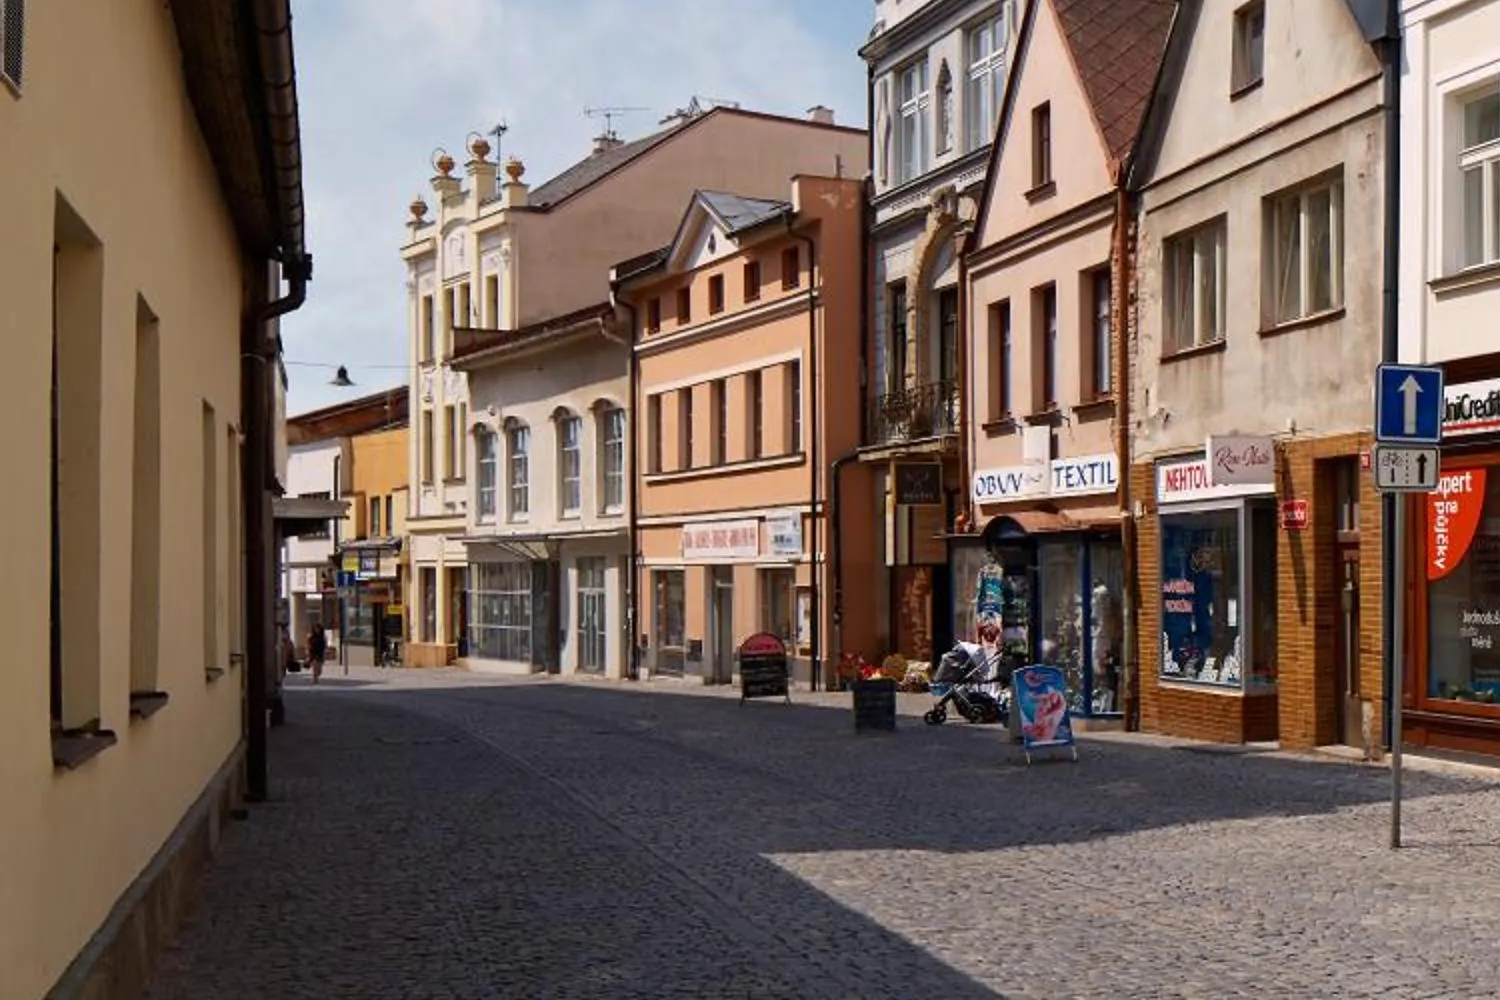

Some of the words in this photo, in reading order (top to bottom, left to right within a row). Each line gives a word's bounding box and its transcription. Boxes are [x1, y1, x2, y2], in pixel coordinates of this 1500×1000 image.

[1053, 460, 1117, 488] TEXTIL
[1166, 463, 1209, 492] NEHTO
[1429, 471, 1473, 499] xpert
